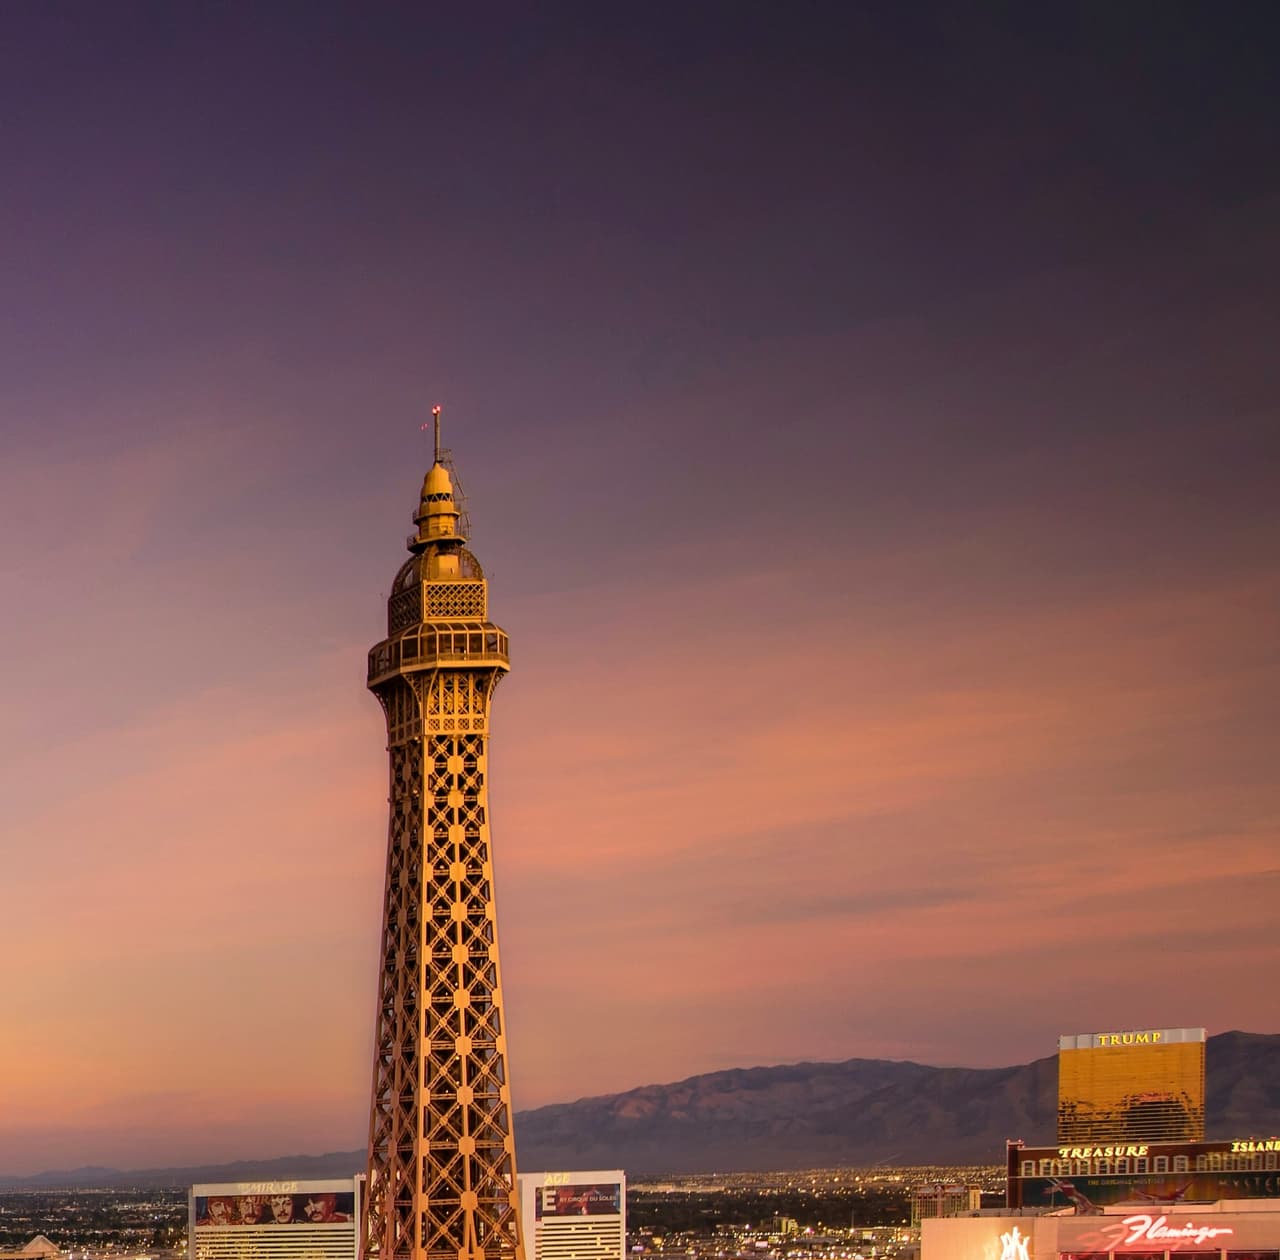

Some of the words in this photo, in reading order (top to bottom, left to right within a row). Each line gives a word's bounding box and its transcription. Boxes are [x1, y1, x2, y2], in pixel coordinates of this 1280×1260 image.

[1099, 1032, 1161, 1046] TRUMP
[1058, 1145, 1149, 1159] TREASURE
[1231, 1140, 1280, 1153] ISLAND
[1122, 1214, 1233, 1244] Flamingo
